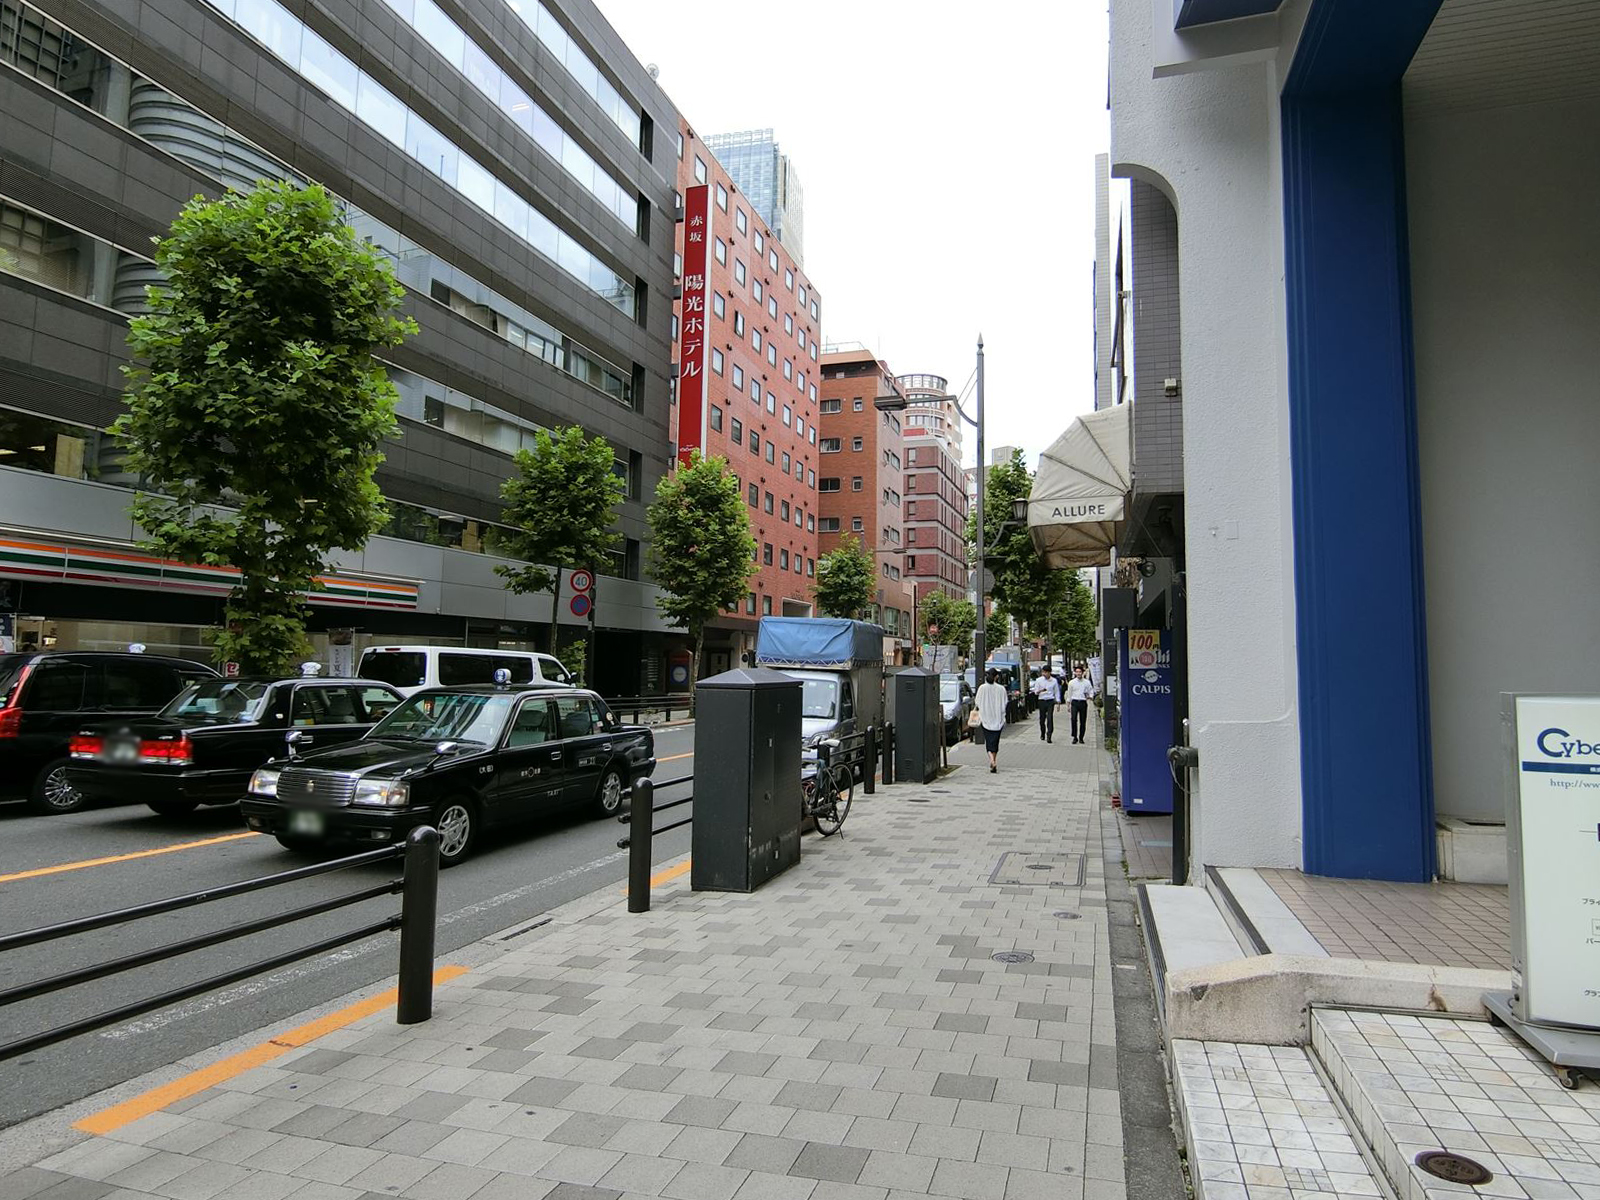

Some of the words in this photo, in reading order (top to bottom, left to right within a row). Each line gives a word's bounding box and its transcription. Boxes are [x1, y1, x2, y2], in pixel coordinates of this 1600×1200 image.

[690, 214, 703, 242] 赤坂
[681, 273, 704, 378] 陽光ホテル
[1052, 504, 1105, 518] ALLURE
[575, 576, 588, 587] 40
[1132, 684, 1171, 695] CALPIS
